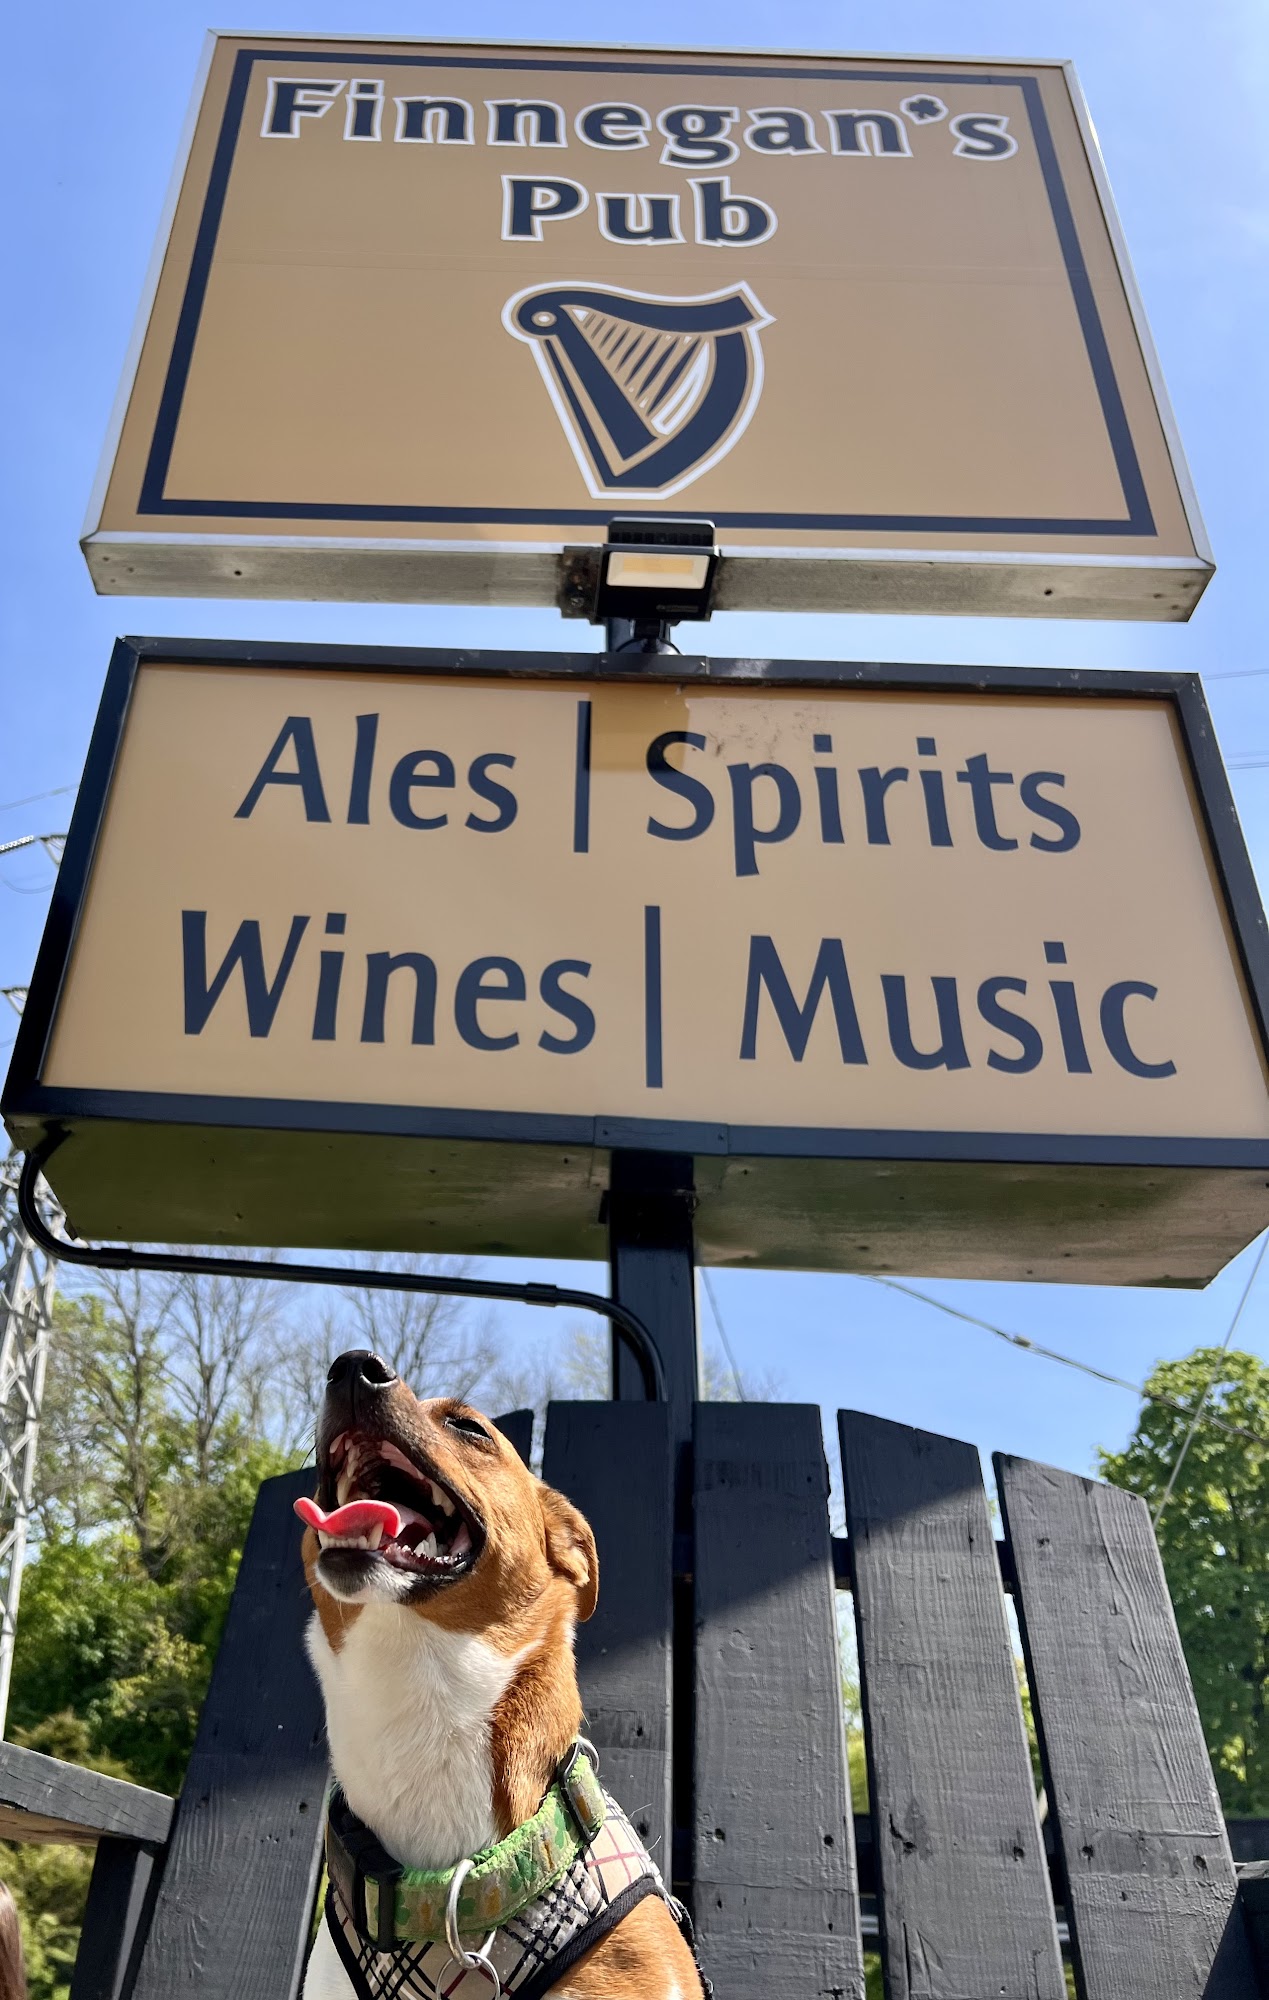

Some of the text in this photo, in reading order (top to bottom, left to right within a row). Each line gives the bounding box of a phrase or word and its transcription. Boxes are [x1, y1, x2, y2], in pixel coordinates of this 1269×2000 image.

[262, 77, 1019, 169] Finnegan's
[500, 174, 778, 248] Pub
[233, 712, 519, 834] Ales
[645, 730, 1081, 878] Spirits
[181, 909, 596, 1055] Wines
[739, 935, 1178, 1079] Music
